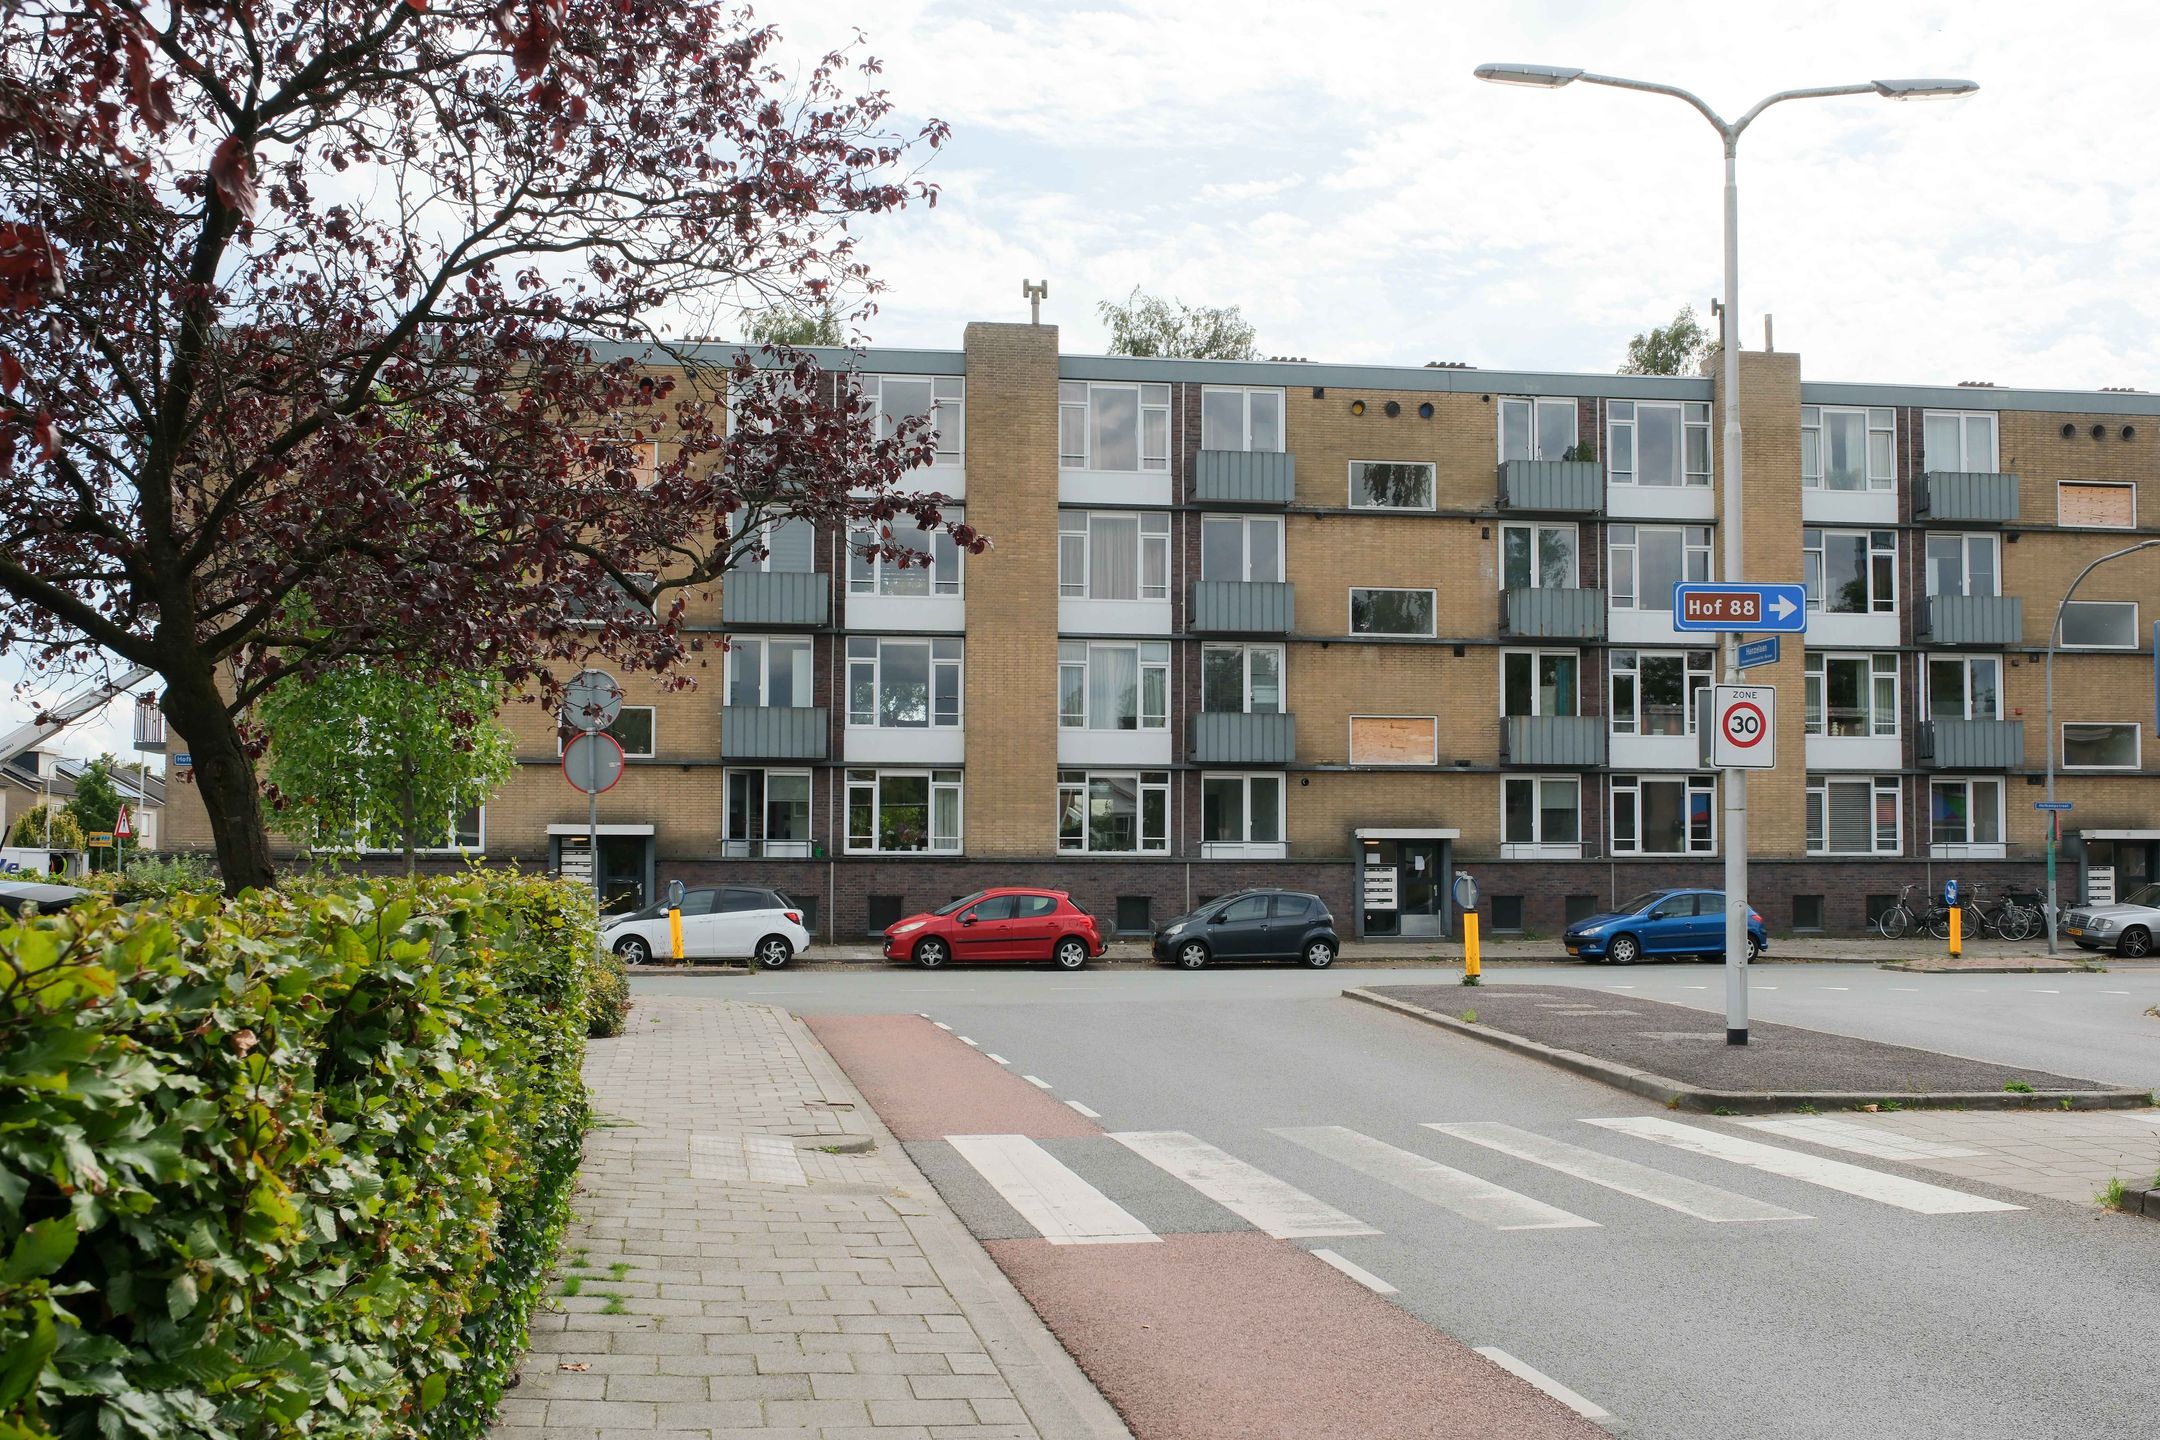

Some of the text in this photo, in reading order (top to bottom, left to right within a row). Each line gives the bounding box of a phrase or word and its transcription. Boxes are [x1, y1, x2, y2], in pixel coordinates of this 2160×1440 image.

[1689, 599, 1755, 616] Hof 88
[1732, 690, 1758, 699] ZONE
[1731, 715, 1759, 734] 30
